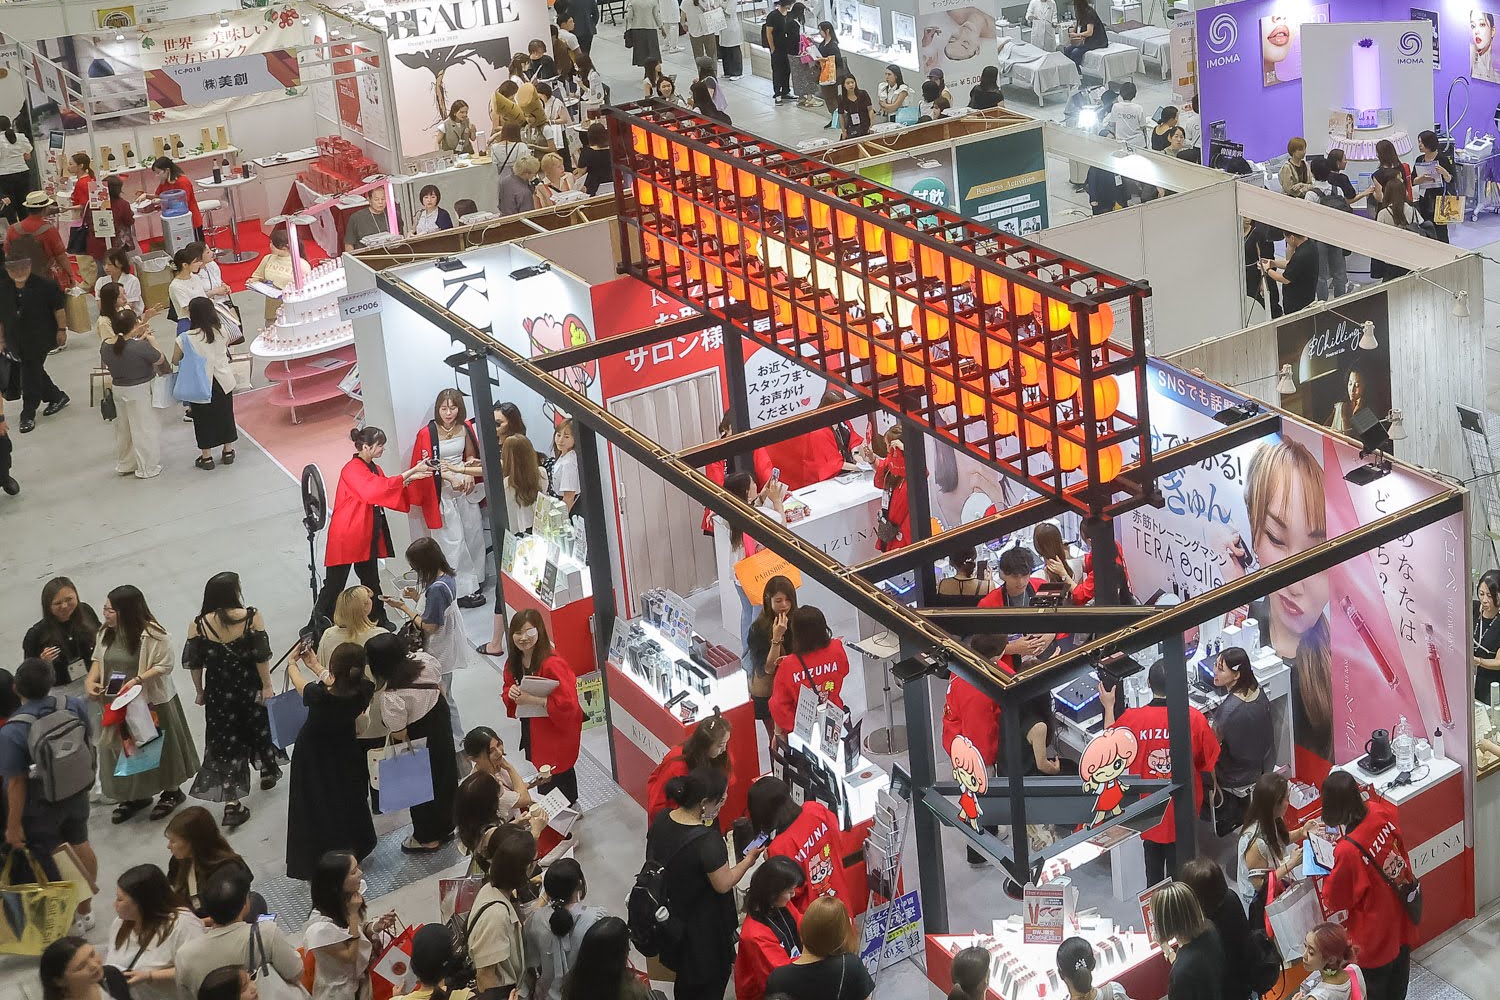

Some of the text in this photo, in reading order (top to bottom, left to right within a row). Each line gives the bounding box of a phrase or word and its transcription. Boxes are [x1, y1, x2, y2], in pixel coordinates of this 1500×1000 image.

[163, 24, 268, 53] 世界一美味しい
[174, 66, 202, 75] 1C-P018
[1206, 54, 1241, 69] IMOMA
[1397, 57, 1425, 65] IMOMA
[975, 175, 1036, 196] Business Activities
[344, 301, 379, 316] 1C-P006
[760, 384, 804, 406] お声がけ
[757, 401, 801, 421] ください
[1132, 509, 1228, 567] 赤筋トレーニングマシン
[1132, 526, 1175, 569] TERA
[793, 660, 839, 684] KIZUNA
[631, 725, 666, 758] KIZUN
[1139, 727, 1170, 741] KIZU
[1413, 833, 1463, 868] IZUNA
